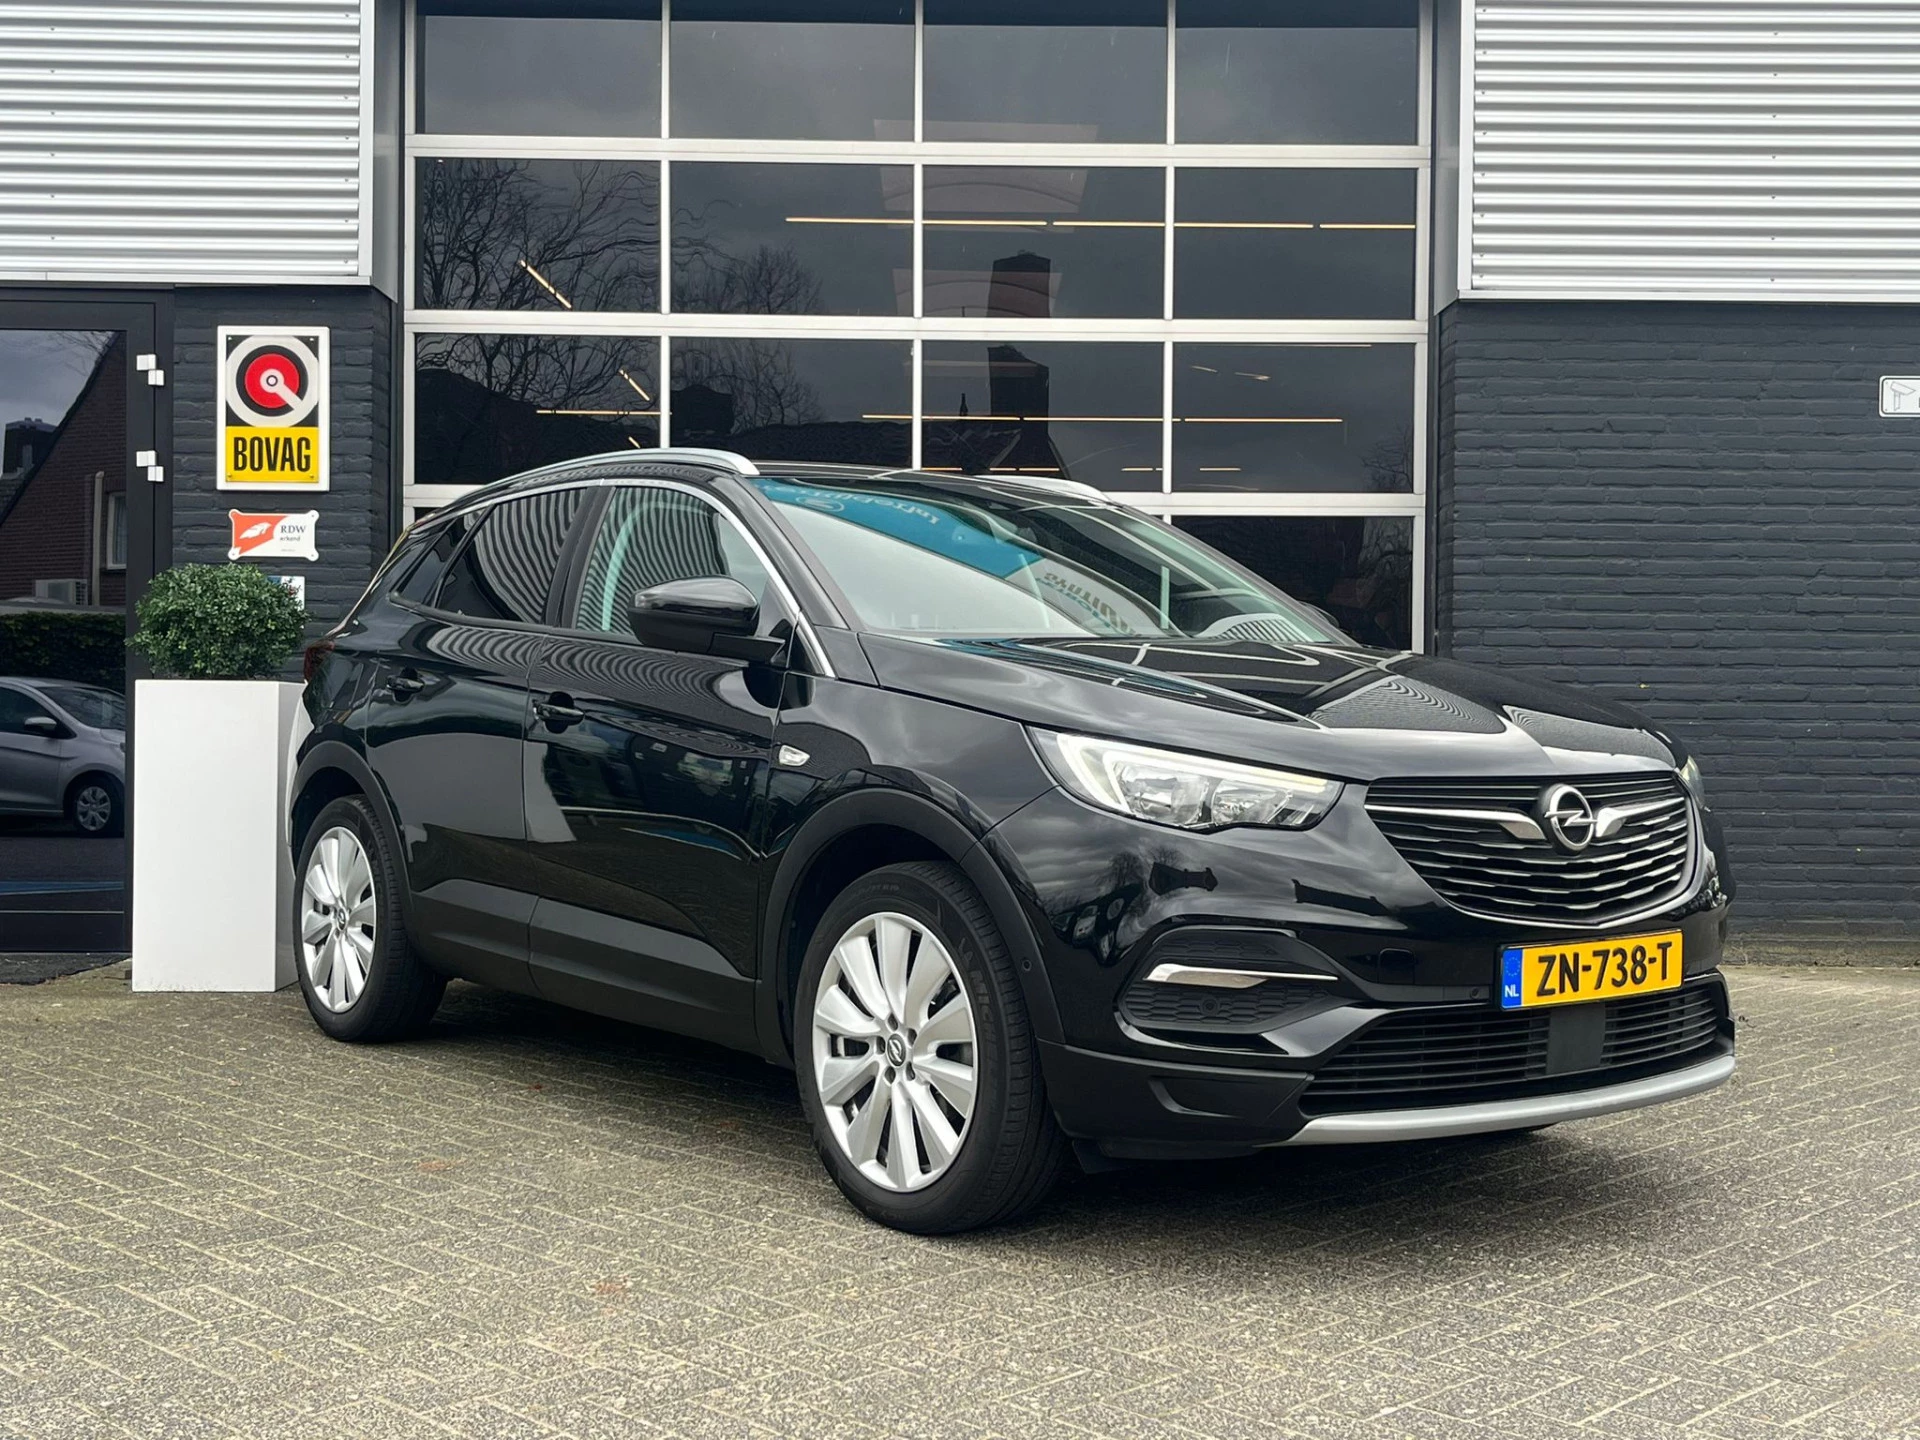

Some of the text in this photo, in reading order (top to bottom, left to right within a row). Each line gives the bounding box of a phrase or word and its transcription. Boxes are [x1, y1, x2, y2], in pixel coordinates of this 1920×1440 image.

[233, 436, 311, 472] BOVAG
[280, 525, 306, 534] RDW
[1536, 941, 1673, 998] ZN-738-T
[1504, 984, 1519, 998] NL
